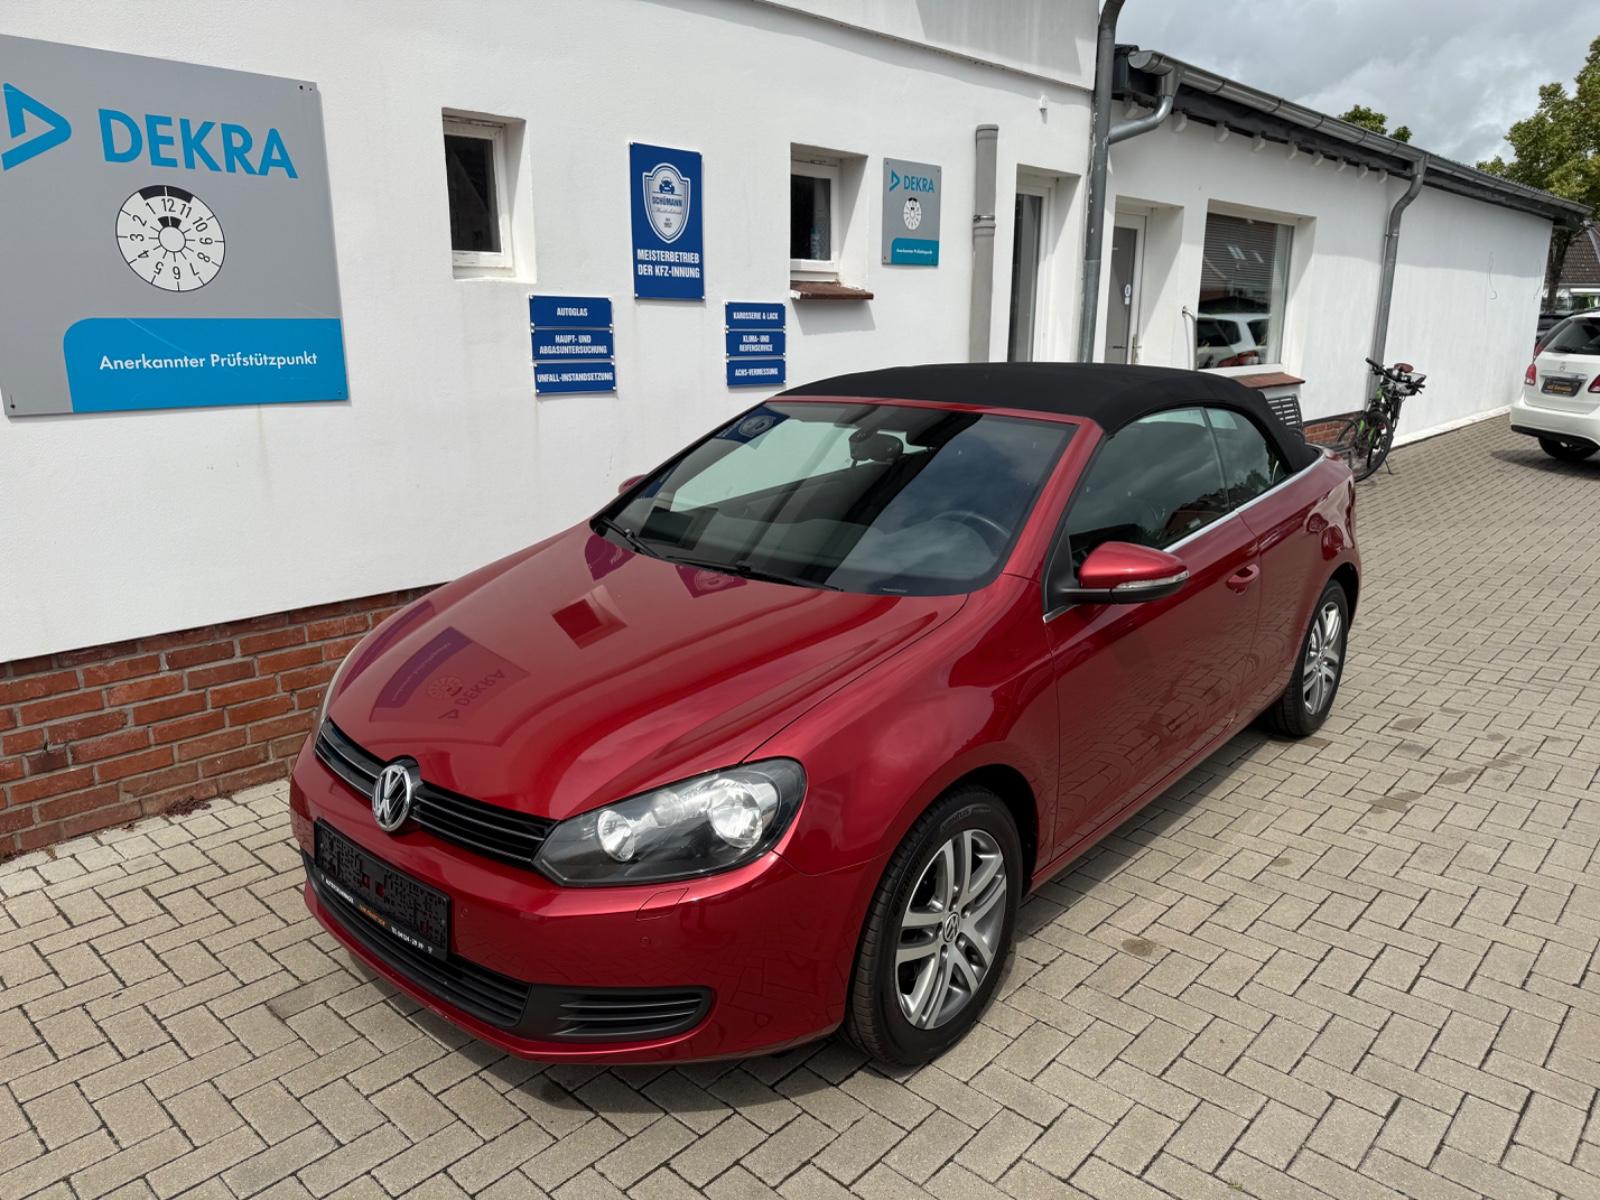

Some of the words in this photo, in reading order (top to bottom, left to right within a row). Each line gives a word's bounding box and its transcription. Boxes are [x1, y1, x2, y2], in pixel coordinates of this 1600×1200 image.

[98, 108, 299, 179] DEKRA
[903, 175, 935, 193] DEKRA
[145, 202, 156, 215] 1
[161, 198, 176, 212] 12
[179, 203, 192, 219] 11
[132, 215, 147, 227] 2
[192, 216, 208, 232] 10
[129, 233, 145, 242] 3
[199, 237, 213, 245] 9
[138, 250, 149, 259] 4
[197, 252, 211, 263] 8
[637, 249, 699, 264] MEISTERBETRIEB
[153, 261, 164, 275] 5
[172, 266, 181, 280] 6
[189, 262, 199, 276] 7
[637, 264, 653, 276] DER
[655, 265, 700, 278] KFZ-INNUNG
[556, 307, 588, 317] AUTOGLAS
[555, 335, 577, 343] HAUPT-
[578, 335, 591, 343] UND
[100, 354, 206, 371] Anerkannter
[211, 351, 318, 370] Prüfstützpunkt
